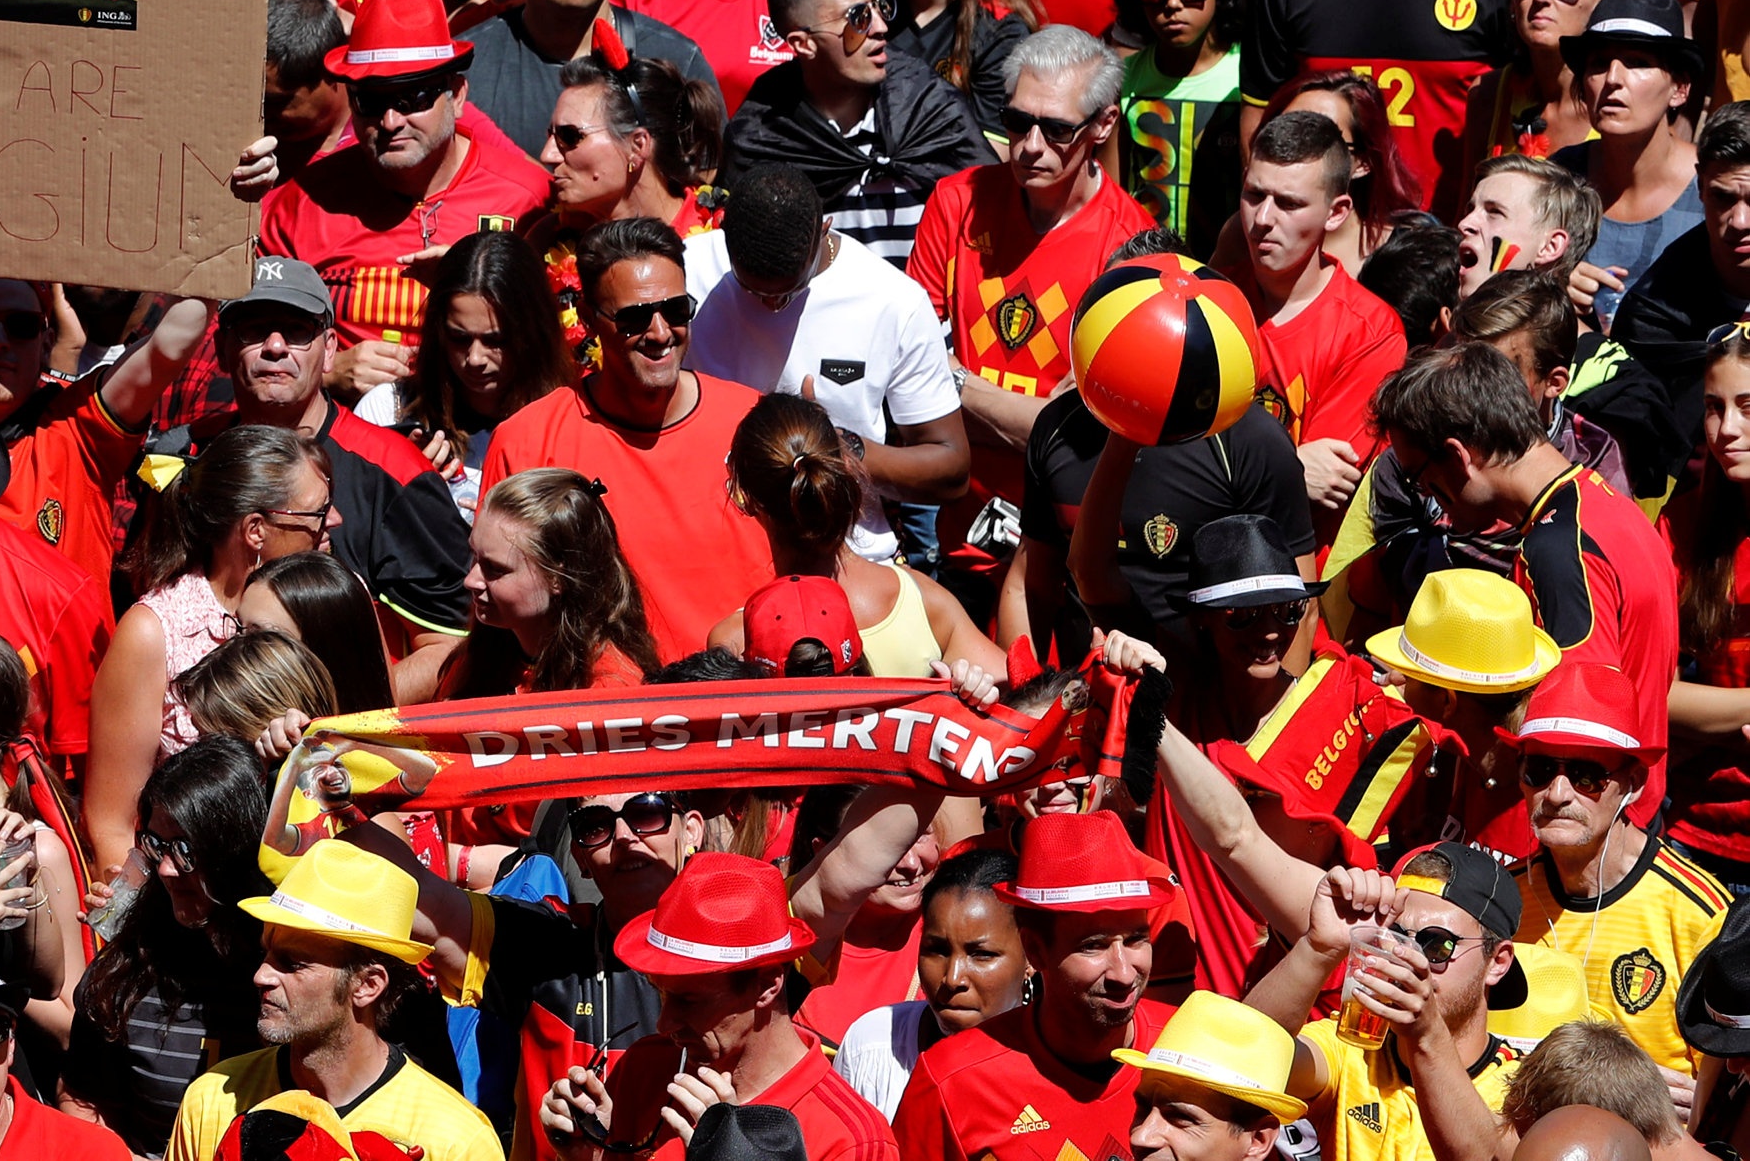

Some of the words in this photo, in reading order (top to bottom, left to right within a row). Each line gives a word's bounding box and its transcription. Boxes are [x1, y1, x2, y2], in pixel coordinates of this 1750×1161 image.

[96, 10, 117, 21] ING
[748, 44, 795, 61] Belgium
[16, 59, 145, 120] ARE
[462, 712, 692, 771] DRIES
[1010, 1120, 1052, 1136] adidas
[1346, 1107, 1383, 1134] adidas
